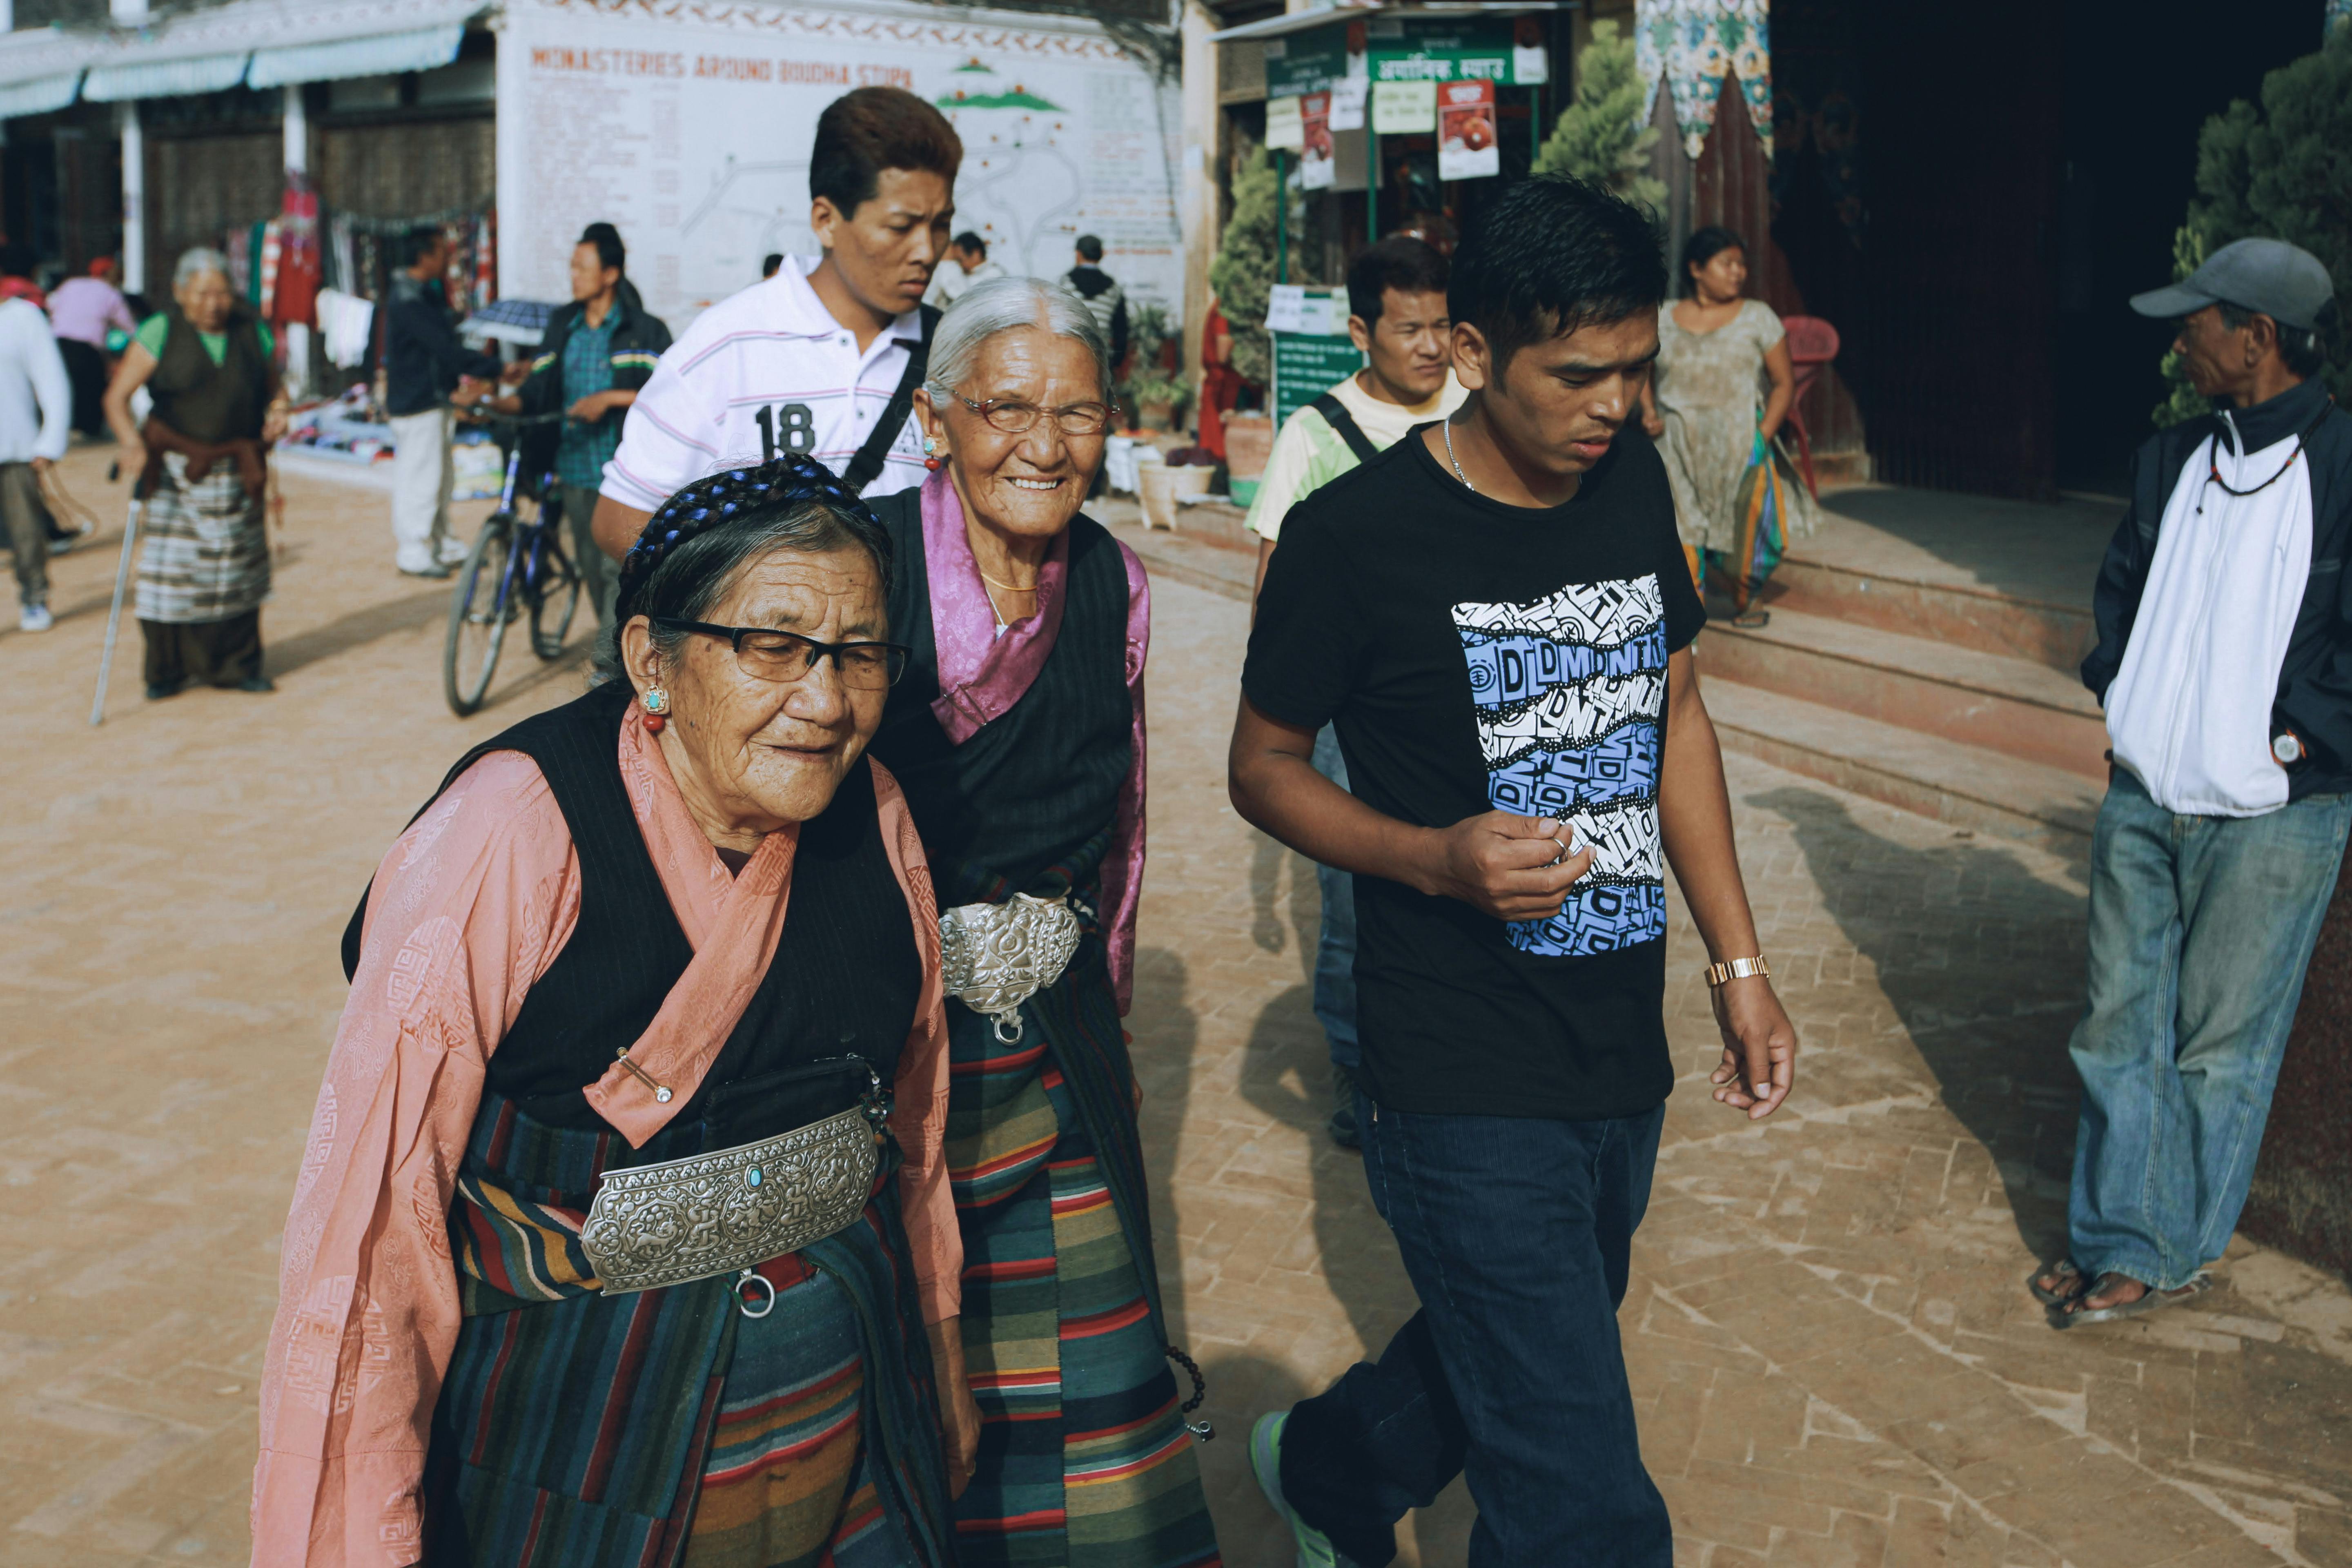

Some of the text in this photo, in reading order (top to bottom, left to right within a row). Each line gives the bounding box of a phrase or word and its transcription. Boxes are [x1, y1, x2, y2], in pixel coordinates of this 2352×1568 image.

[532, 47, 686, 77] MONASTERIES
[695, 56, 772, 81] AROUND
[756, 403, 815, 464] 18
